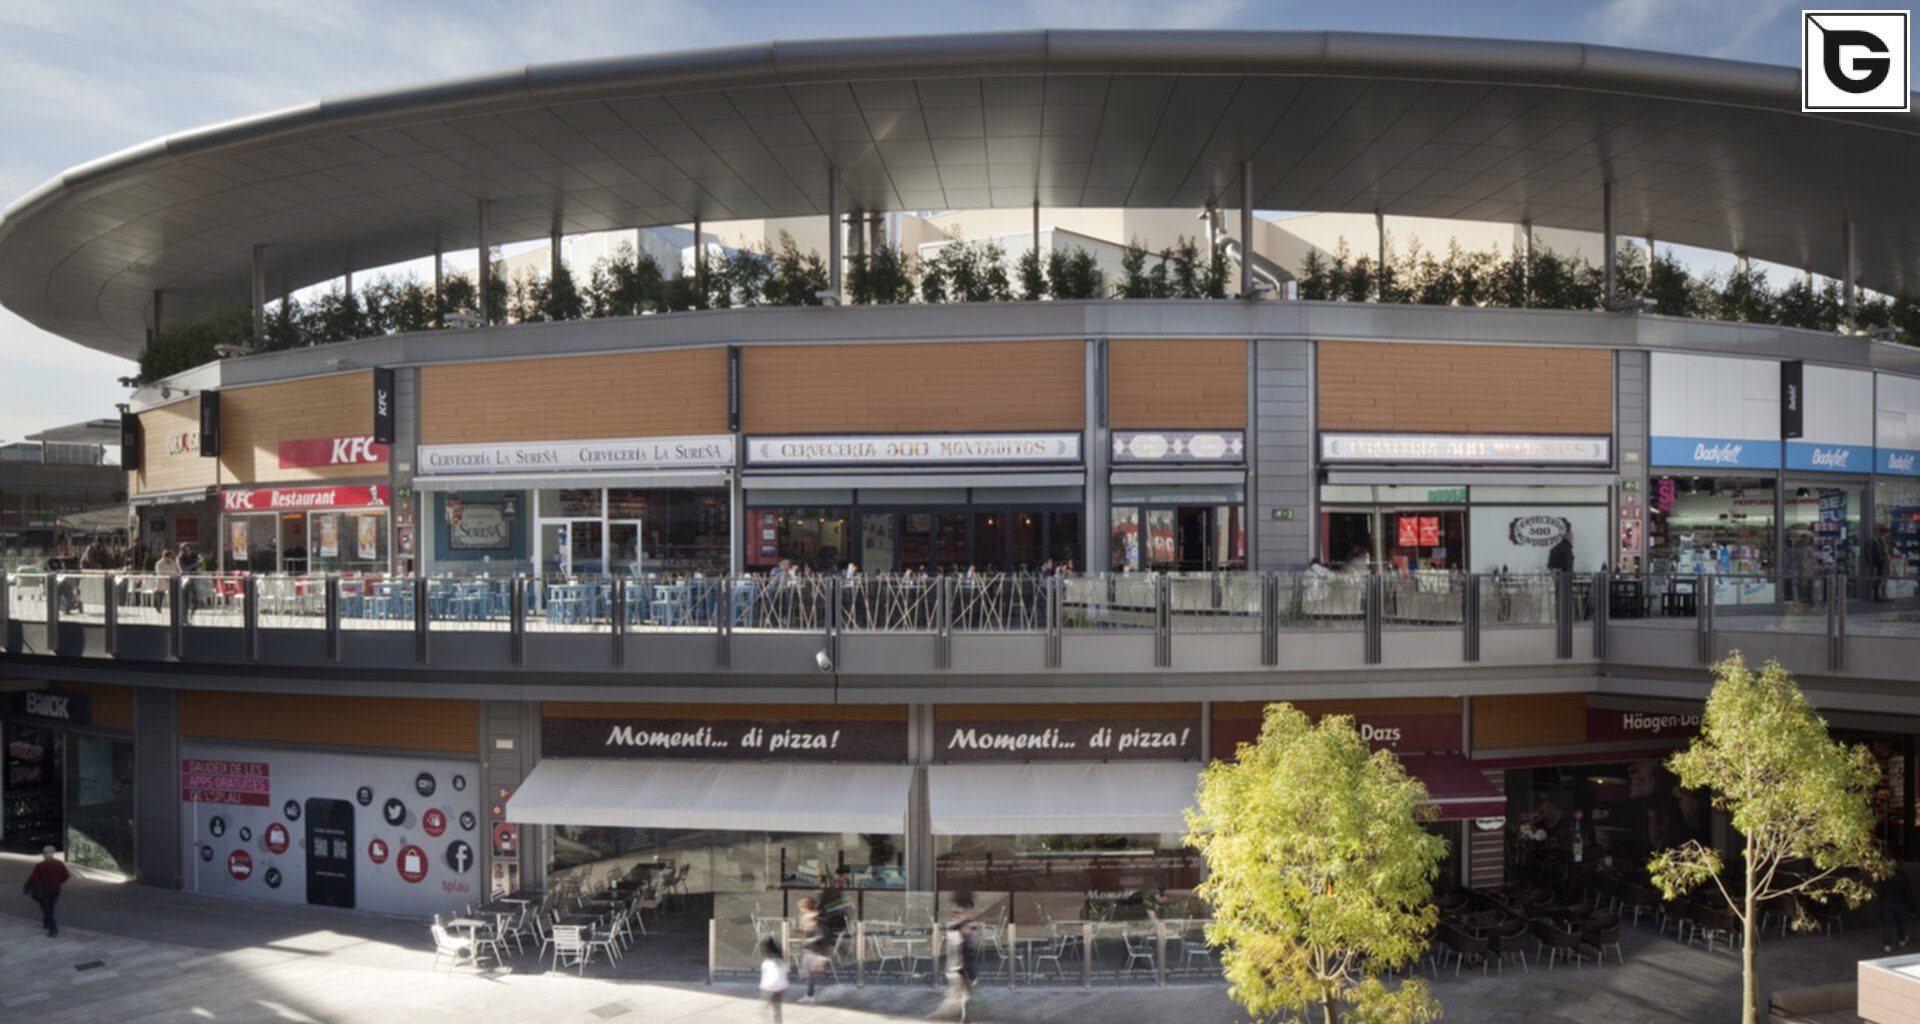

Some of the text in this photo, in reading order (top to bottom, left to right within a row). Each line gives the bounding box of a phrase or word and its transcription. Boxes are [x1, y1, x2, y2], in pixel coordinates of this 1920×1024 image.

[378, 389, 387, 416] KFC
[330, 436, 379, 465] KFC
[224, 489, 337, 510] KFC Restaurant
[1623, 712, 1704, 733] Häagen-Da
[605, 725, 841, 752] Momenti... di pizza!
[948, 727, 1190, 752] Momenti... di pizza!
